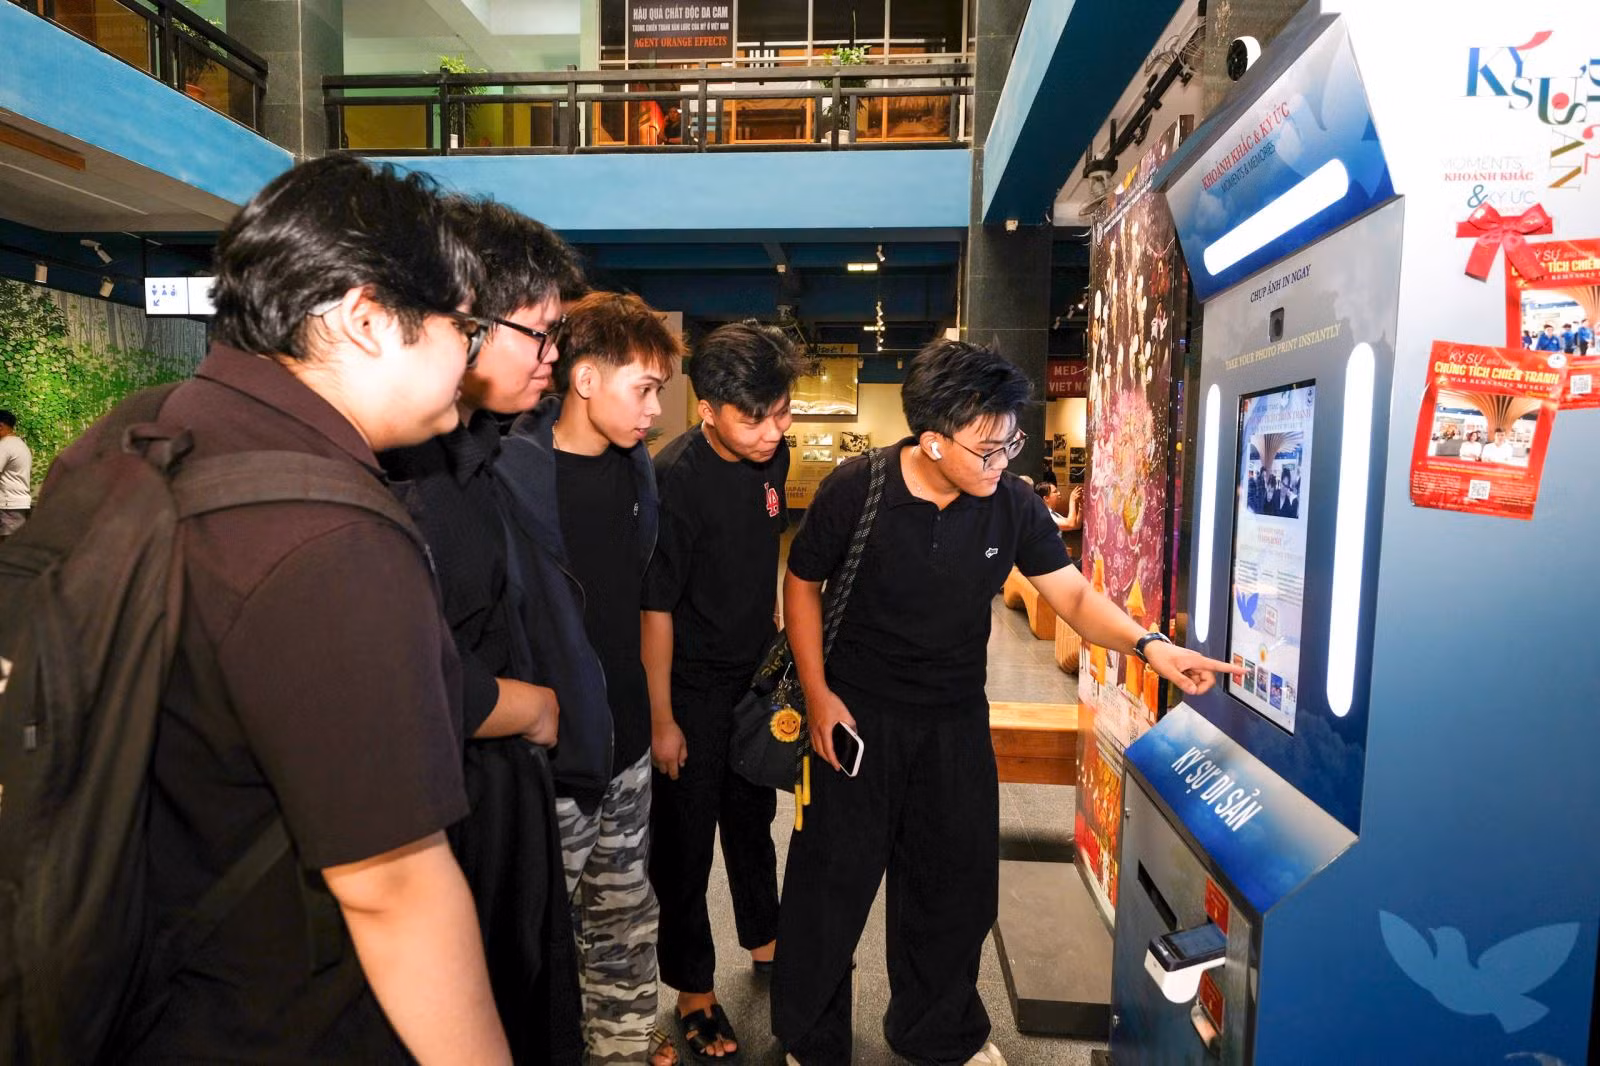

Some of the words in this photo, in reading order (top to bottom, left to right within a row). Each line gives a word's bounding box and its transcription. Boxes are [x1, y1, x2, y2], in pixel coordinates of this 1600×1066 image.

[701, 7, 711, 18] DA
[712, 6, 728, 18] CAM
[634, 37, 658, 48] AGENT
[661, 36, 693, 47] ORANGE
[694, 36, 728, 47] EFFECTS
[1253, 130, 1261, 144] &
[1243, 163, 1250, 176] &
[1248, 142, 1276, 170] MEMORIES
[1440, 156, 1523, 170] MOMENTS
[1467, 184, 1488, 208] &
[1250, 286, 1267, 303] CHỤP
[1267, 279, 1281, 295] ẢNH
[1282, 275, 1291, 288] IN
[1291, 264, 1311, 284] NGAY
[1226, 357, 1239, 370] TAKE
[1239, 353, 1255, 366] YOUR
[1255, 345, 1277, 361] PHOTO
[1277, 337, 1298, 354] PRINT
[1298, 323, 1341, 348] INSTANTLY
[1434, 360, 1467, 376] CHỨNG
[1469, 362, 1490, 379] TÍCH
[1491, 365, 1523, 381] CHIẾN
[1525, 370, 1560, 384] TRANH
[1049, 382, 1073, 392] VIET
[1517, 383, 1553, 392] MUSEUM
[1171, 746, 1211, 775] KÝ
[1185, 760, 1222, 794] SỰ
[1200, 774, 1236, 805] DI
[1214, 788, 1263, 832] SẢN
